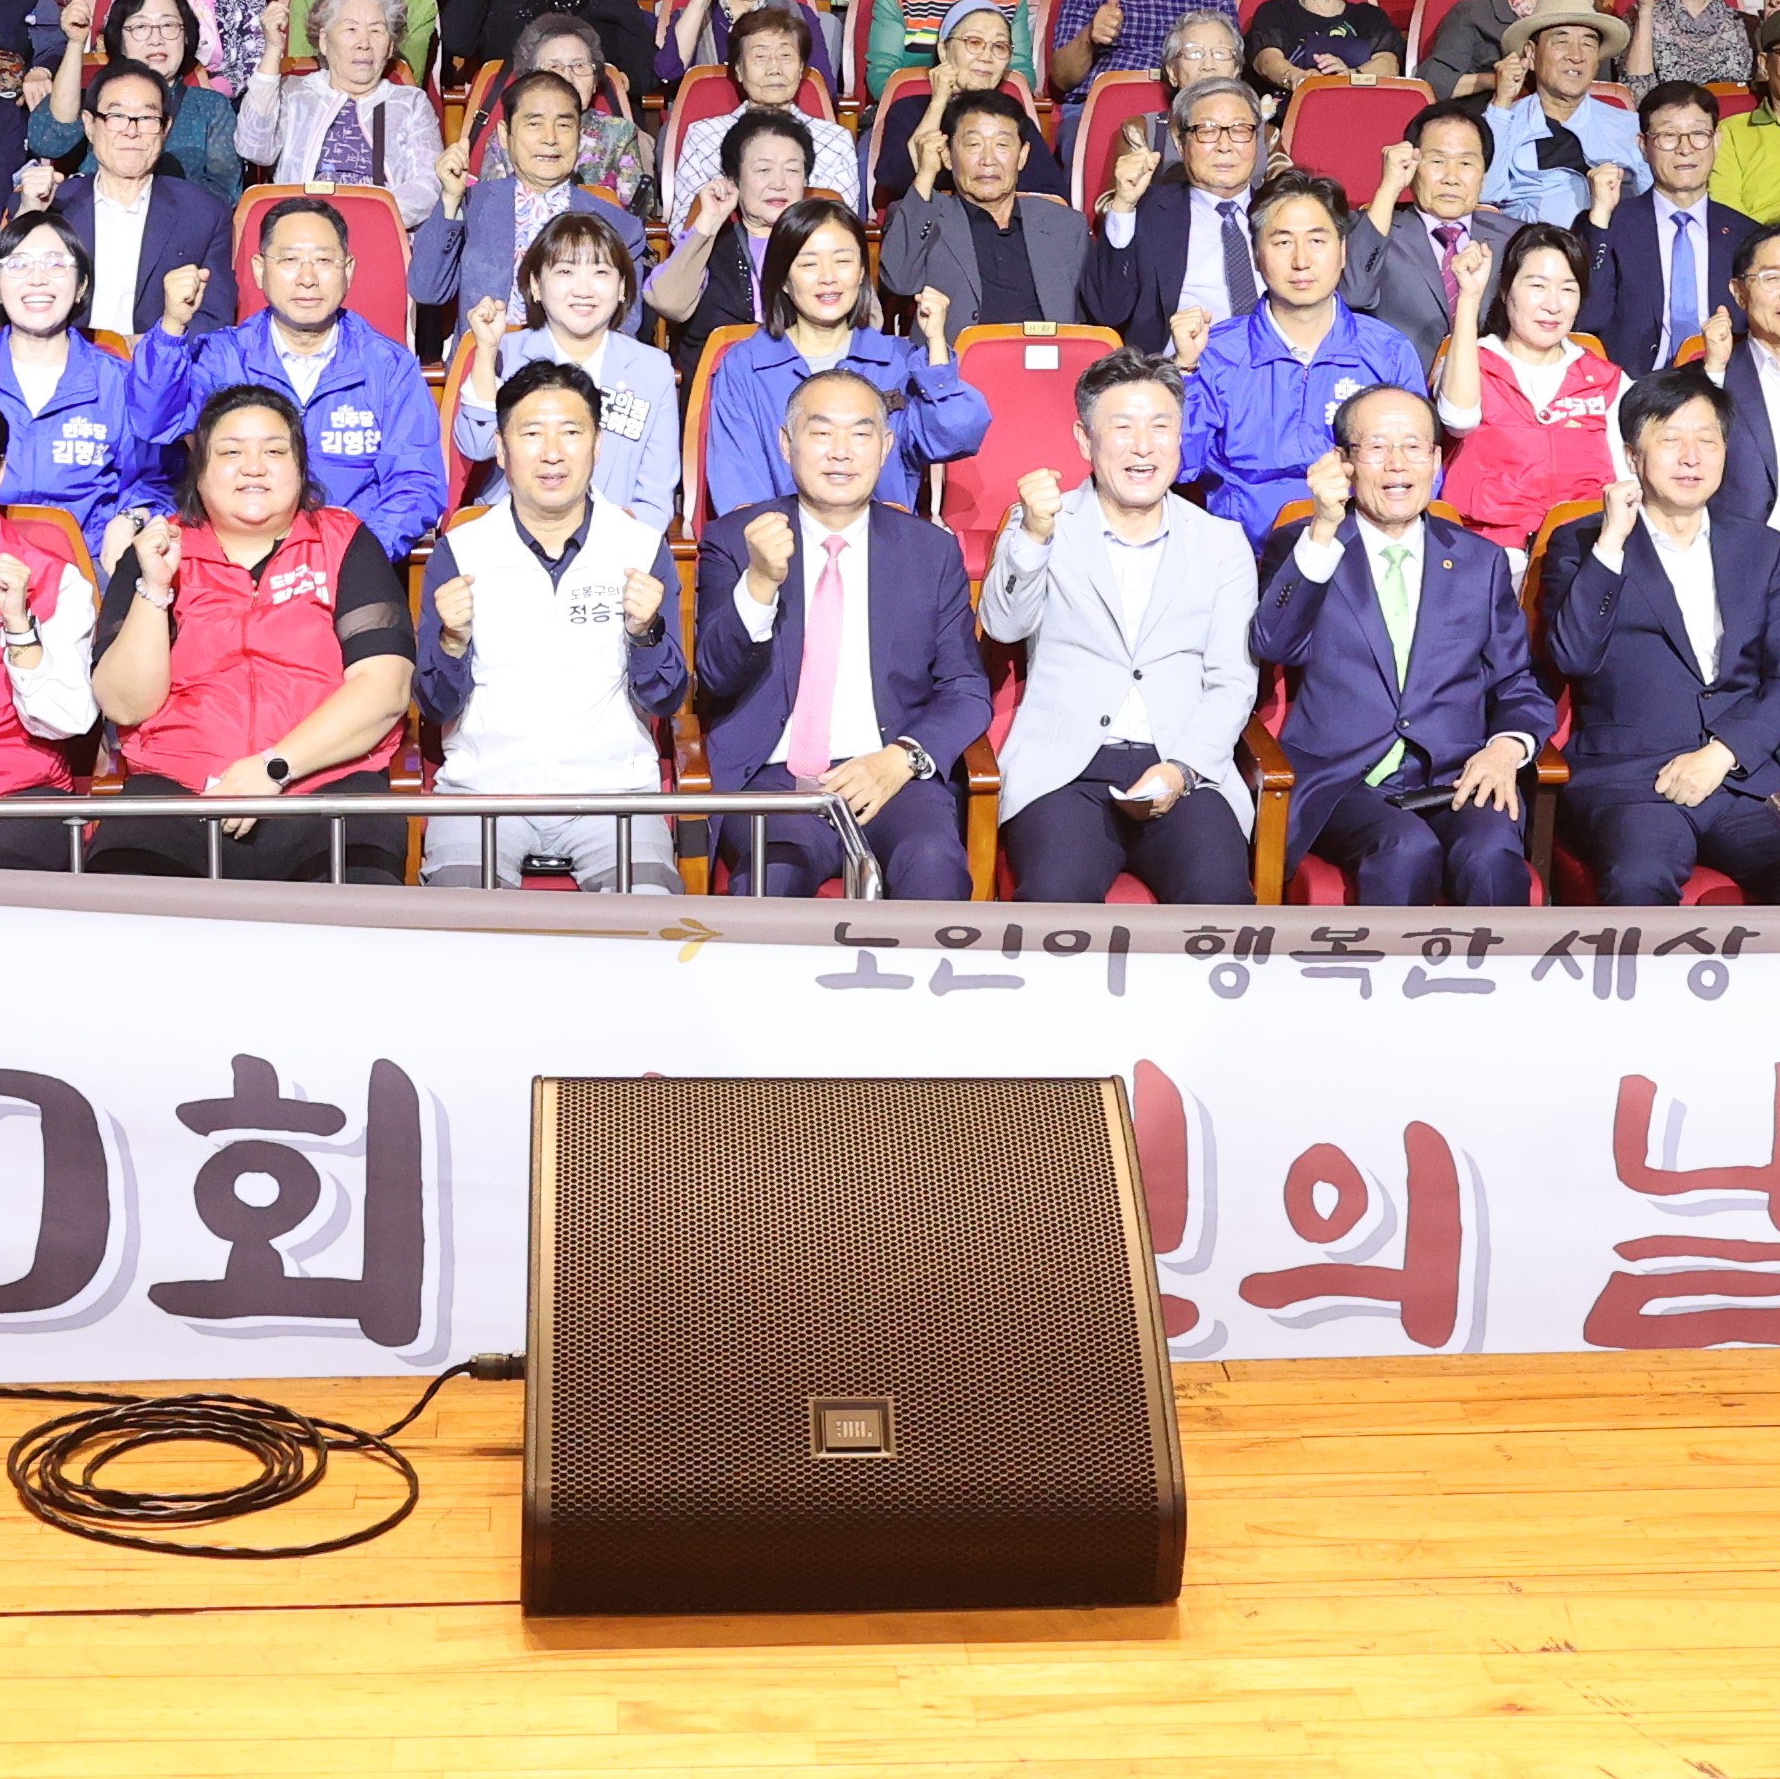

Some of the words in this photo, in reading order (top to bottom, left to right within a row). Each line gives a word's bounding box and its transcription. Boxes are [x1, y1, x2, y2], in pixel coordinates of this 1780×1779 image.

[600, 385, 651, 421] 구의원
[63, 423, 108, 440] 민주당
[569, 585, 621, 601] 도봉구의
[815, 922, 1131, 997] 노인이
[1184, 923, 1505, 1002] 행복한
[1531, 924, 1762, 1003] 세상
[835, 1420, 874, 1439] JBL
